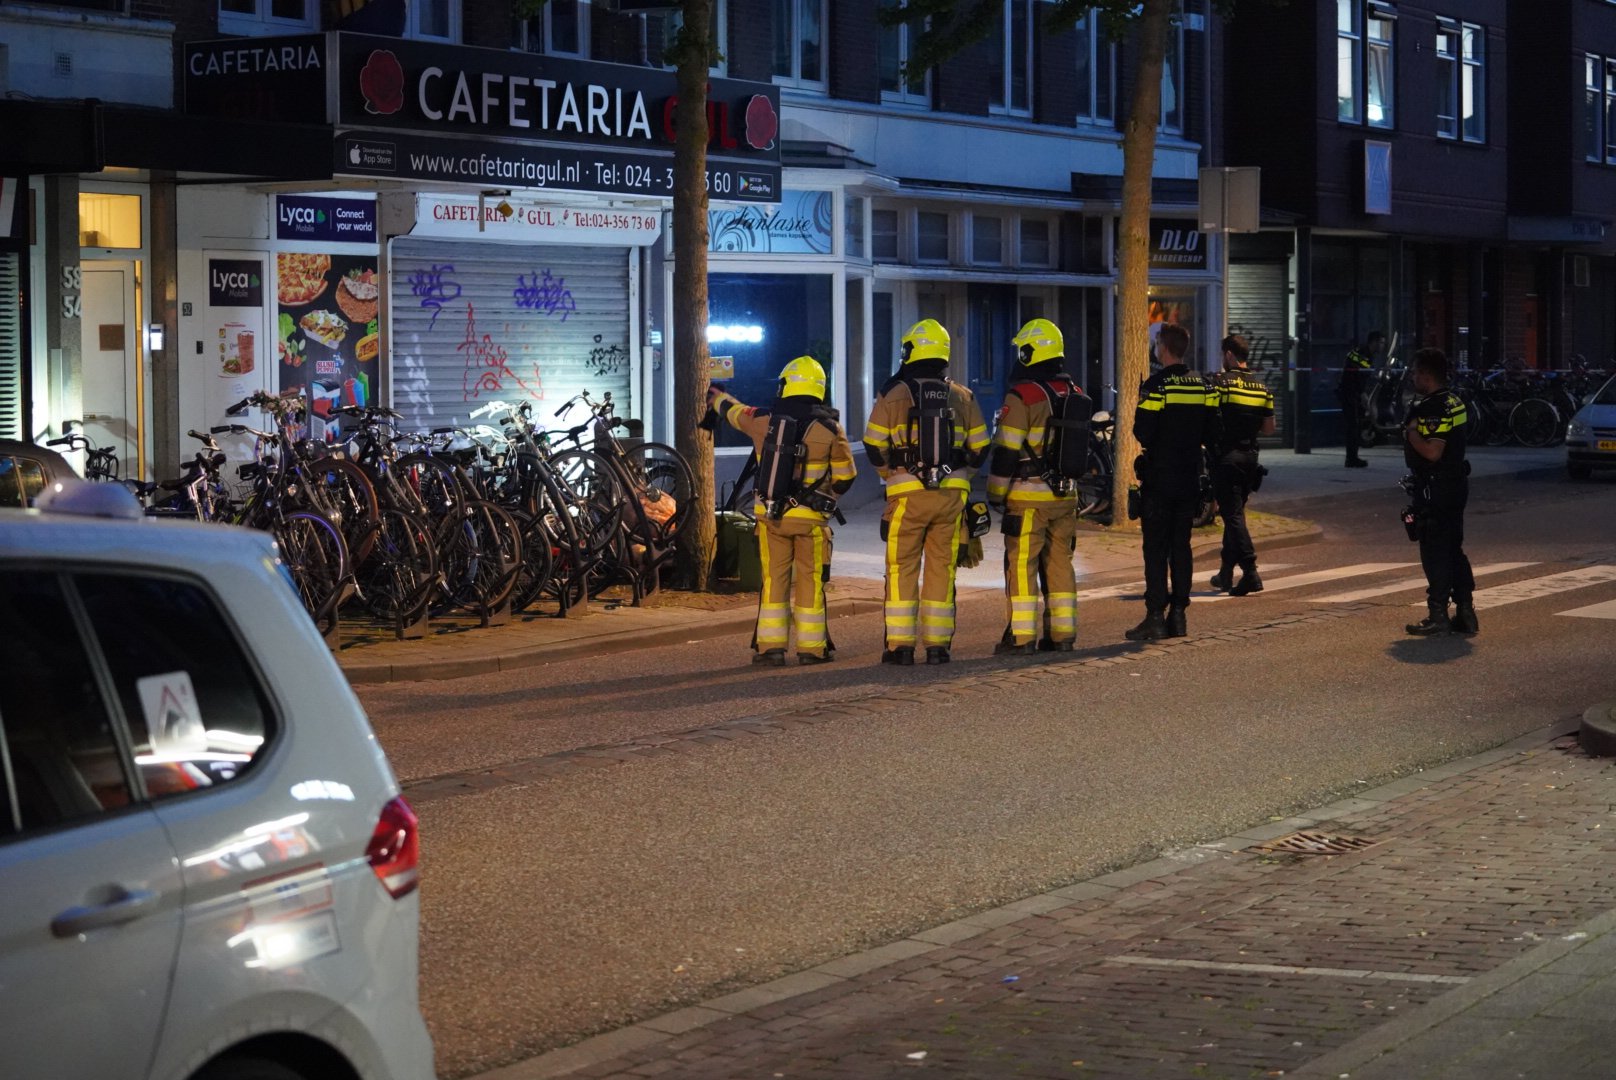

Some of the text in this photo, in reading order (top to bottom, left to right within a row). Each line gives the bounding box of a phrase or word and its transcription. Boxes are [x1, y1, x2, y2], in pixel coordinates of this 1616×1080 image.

[190, 45, 321, 76] CAFETARIA
[418, 66, 652, 139] CAFETARIA
[363, 154, 392, 165] App Store
[410, 154, 580, 186] www.cafetariagul.nl
[594, 162, 620, 185] Tel:
[625, 165, 652, 188] 024
[714, 172, 731, 193] 60
[280, 203, 315, 226] Lyca
[336, 208, 365, 219] Connect
[433, 205, 507, 223] CAFETRIA
[527, 207, 555, 226] GÜL
[631, 215, 641, 229] 73
[644, 216, 656, 230] 60
[295, 224, 315, 233] Mobile
[336, 221, 373, 233] your world
[1158, 229, 1200, 251] DLO
[1152, 254, 1204, 264] BARBERSHOP
[213, 268, 249, 292] Lyca
